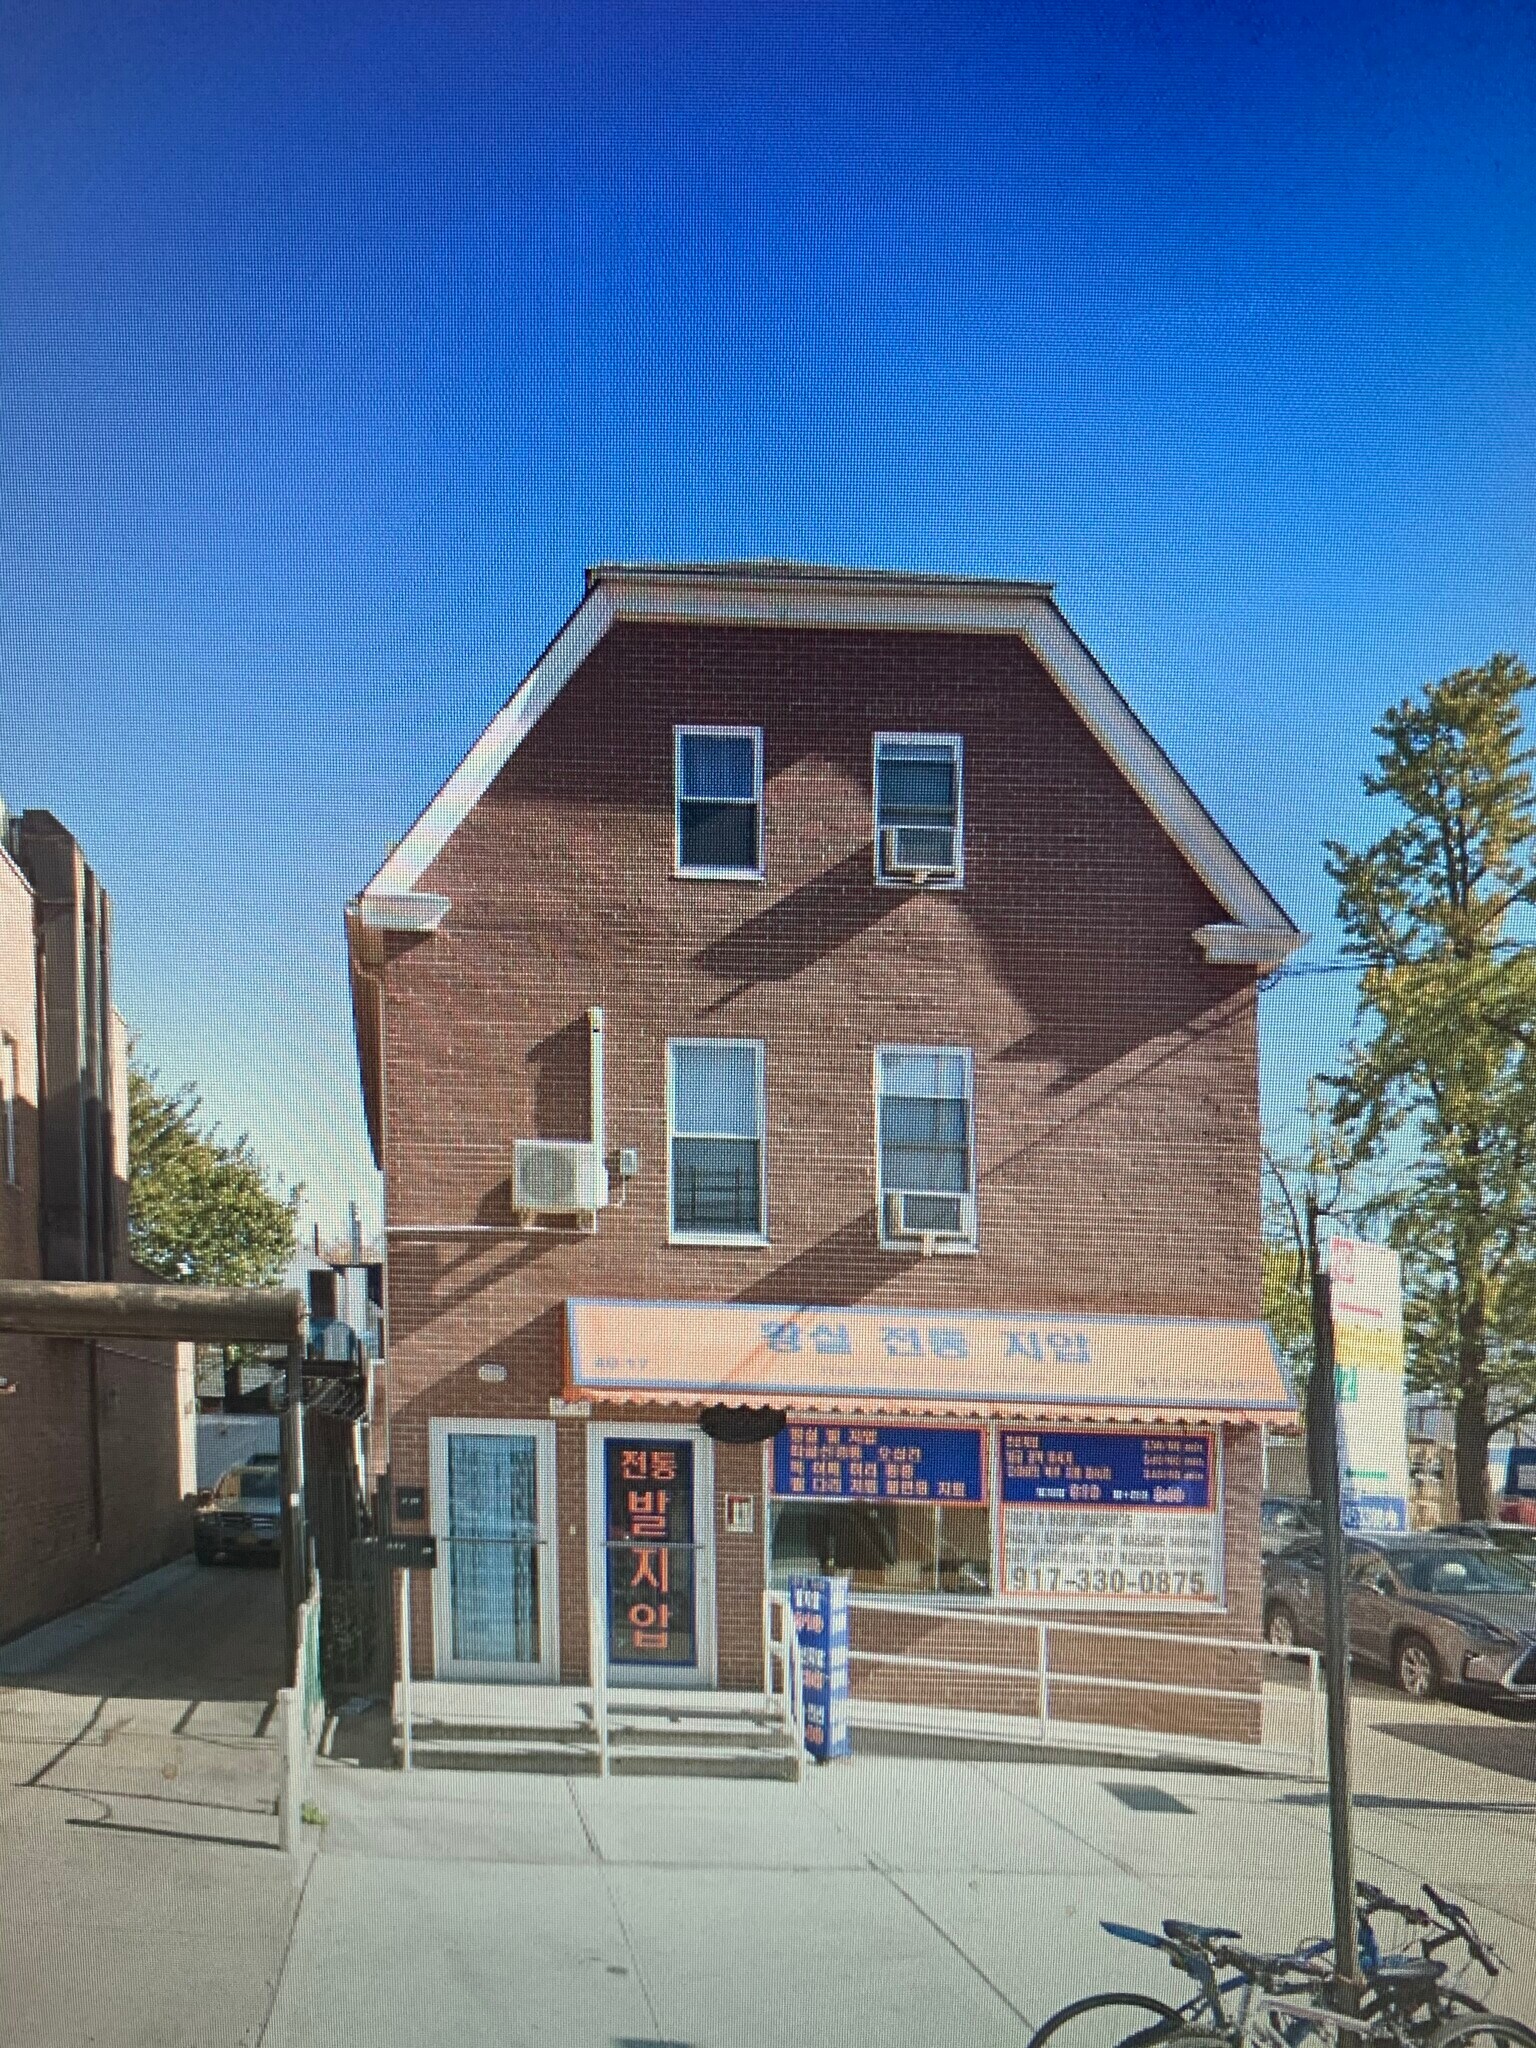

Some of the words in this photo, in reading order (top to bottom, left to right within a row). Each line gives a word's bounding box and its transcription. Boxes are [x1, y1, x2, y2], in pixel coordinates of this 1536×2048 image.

[1003, 1329, 1092, 1364] 지압
[622, 1451, 677, 1480] 전통
[1011, 1565, 1205, 1595] 917-330-0875
